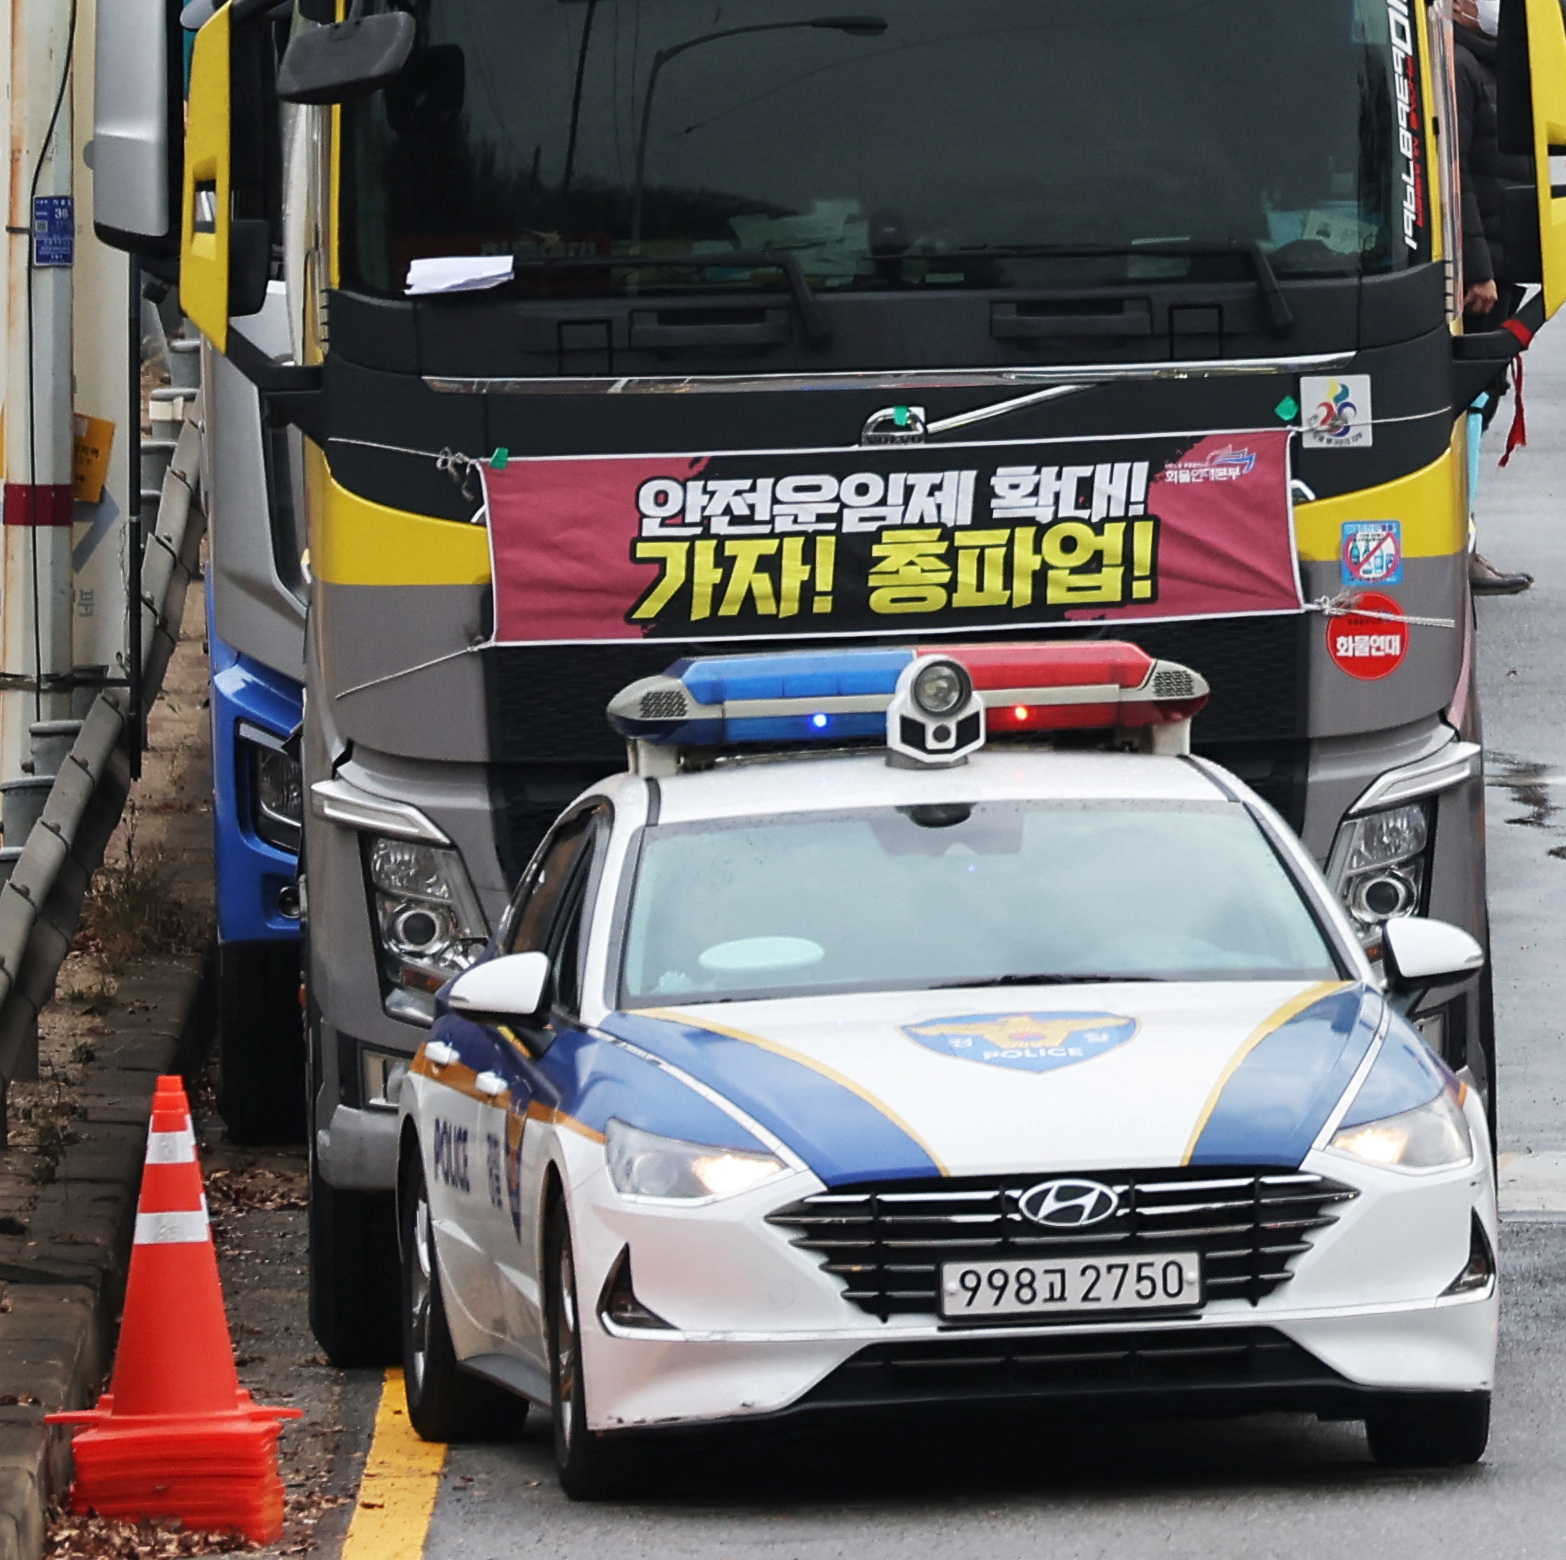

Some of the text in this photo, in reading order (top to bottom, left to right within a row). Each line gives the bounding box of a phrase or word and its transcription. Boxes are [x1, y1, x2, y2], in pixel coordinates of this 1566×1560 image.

[636, 461, 1150, 537] 안전운임제 확대!
[630, 520, 1155, 621] 가자! 총파업!
[1336, 635, 1401, 657] 화물연대
[983, 1048, 1083, 1060] POLICE
[1080, 1260, 1184, 1303] 2750
